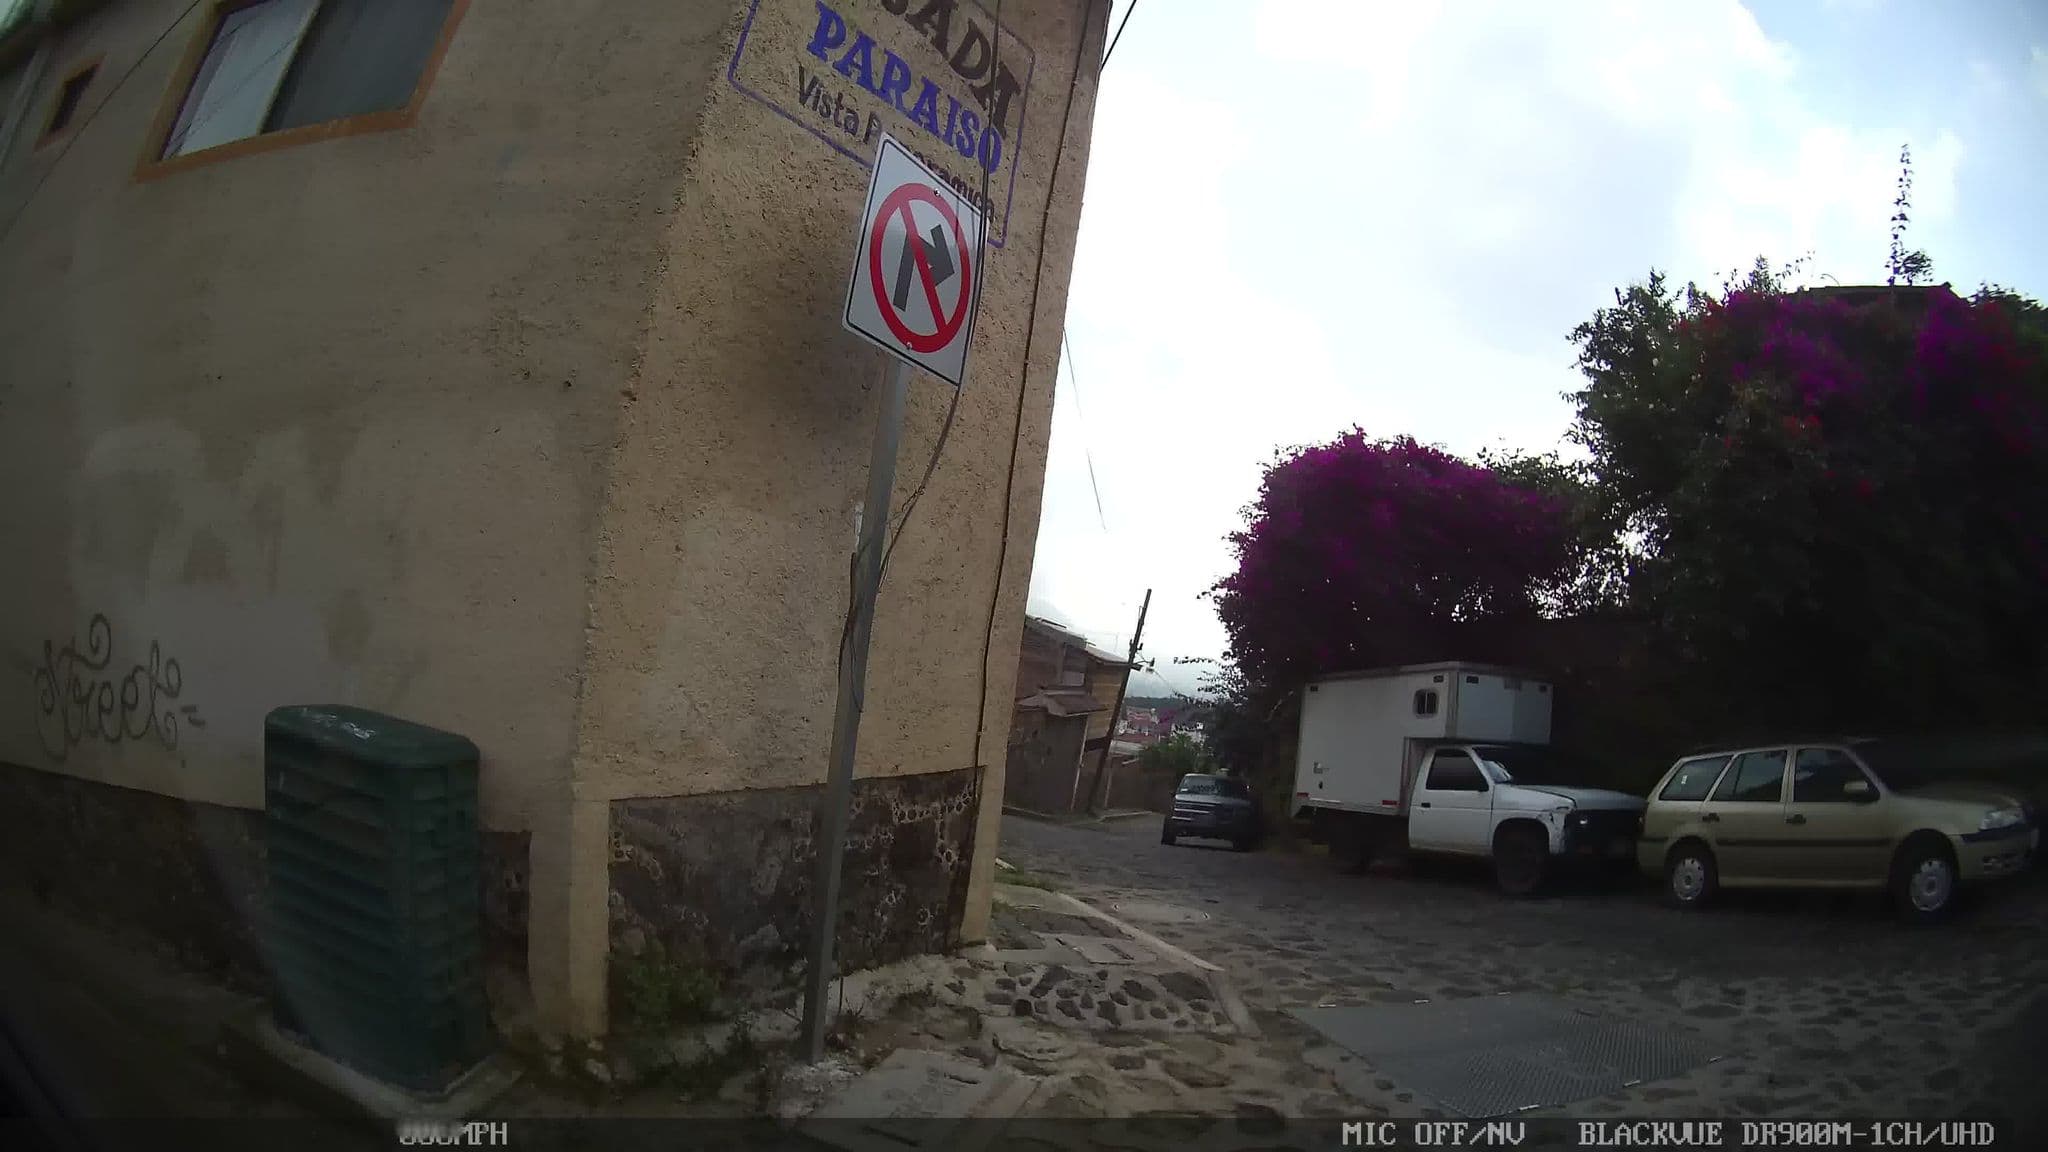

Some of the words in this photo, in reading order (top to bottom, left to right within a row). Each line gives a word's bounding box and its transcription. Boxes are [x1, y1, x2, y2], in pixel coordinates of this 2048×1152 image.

[798, 62, 860, 136] Vista
[806, 0, 1002, 174] PARAISO
[879, 0, 1021, 139] ADA
